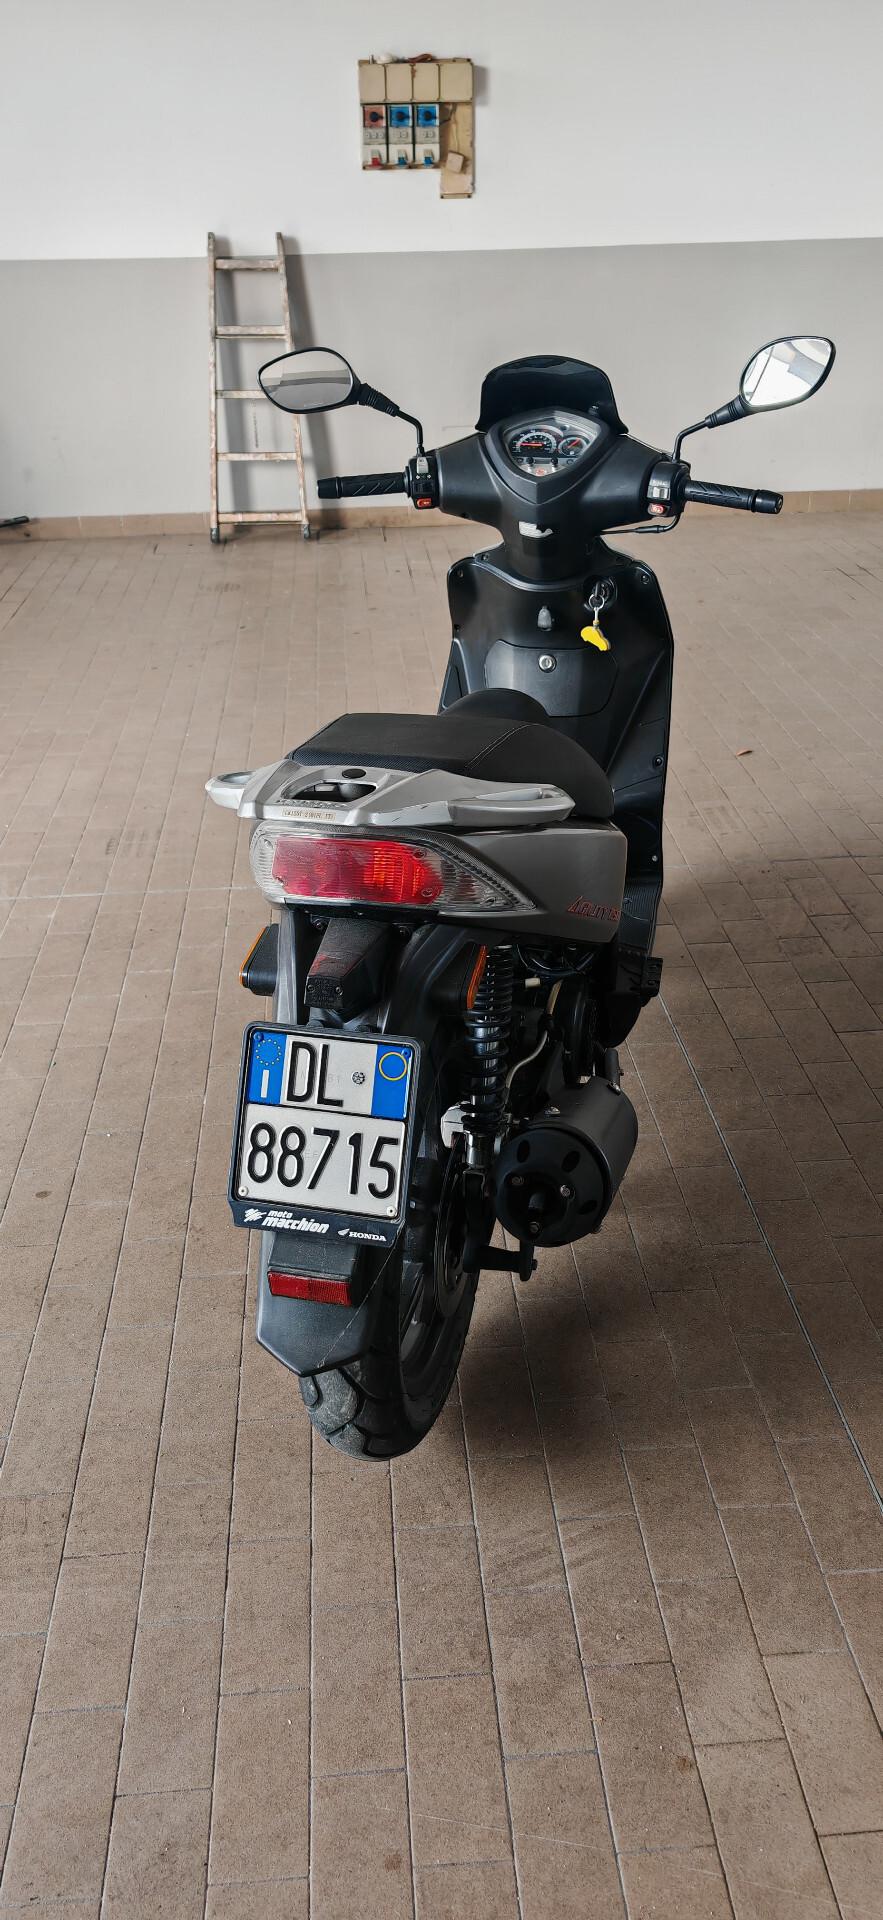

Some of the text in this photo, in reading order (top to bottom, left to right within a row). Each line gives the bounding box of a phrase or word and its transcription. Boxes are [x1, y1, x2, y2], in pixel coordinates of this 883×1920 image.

[260, 1069, 270, 1098] I
[286, 1040, 344, 1108] DL
[247, 1122, 399, 1199] 88715
[261, 1216, 330, 1234] macchion
[267, 1210, 293, 1219] moto
[348, 1231, 387, 1242] HONDA
